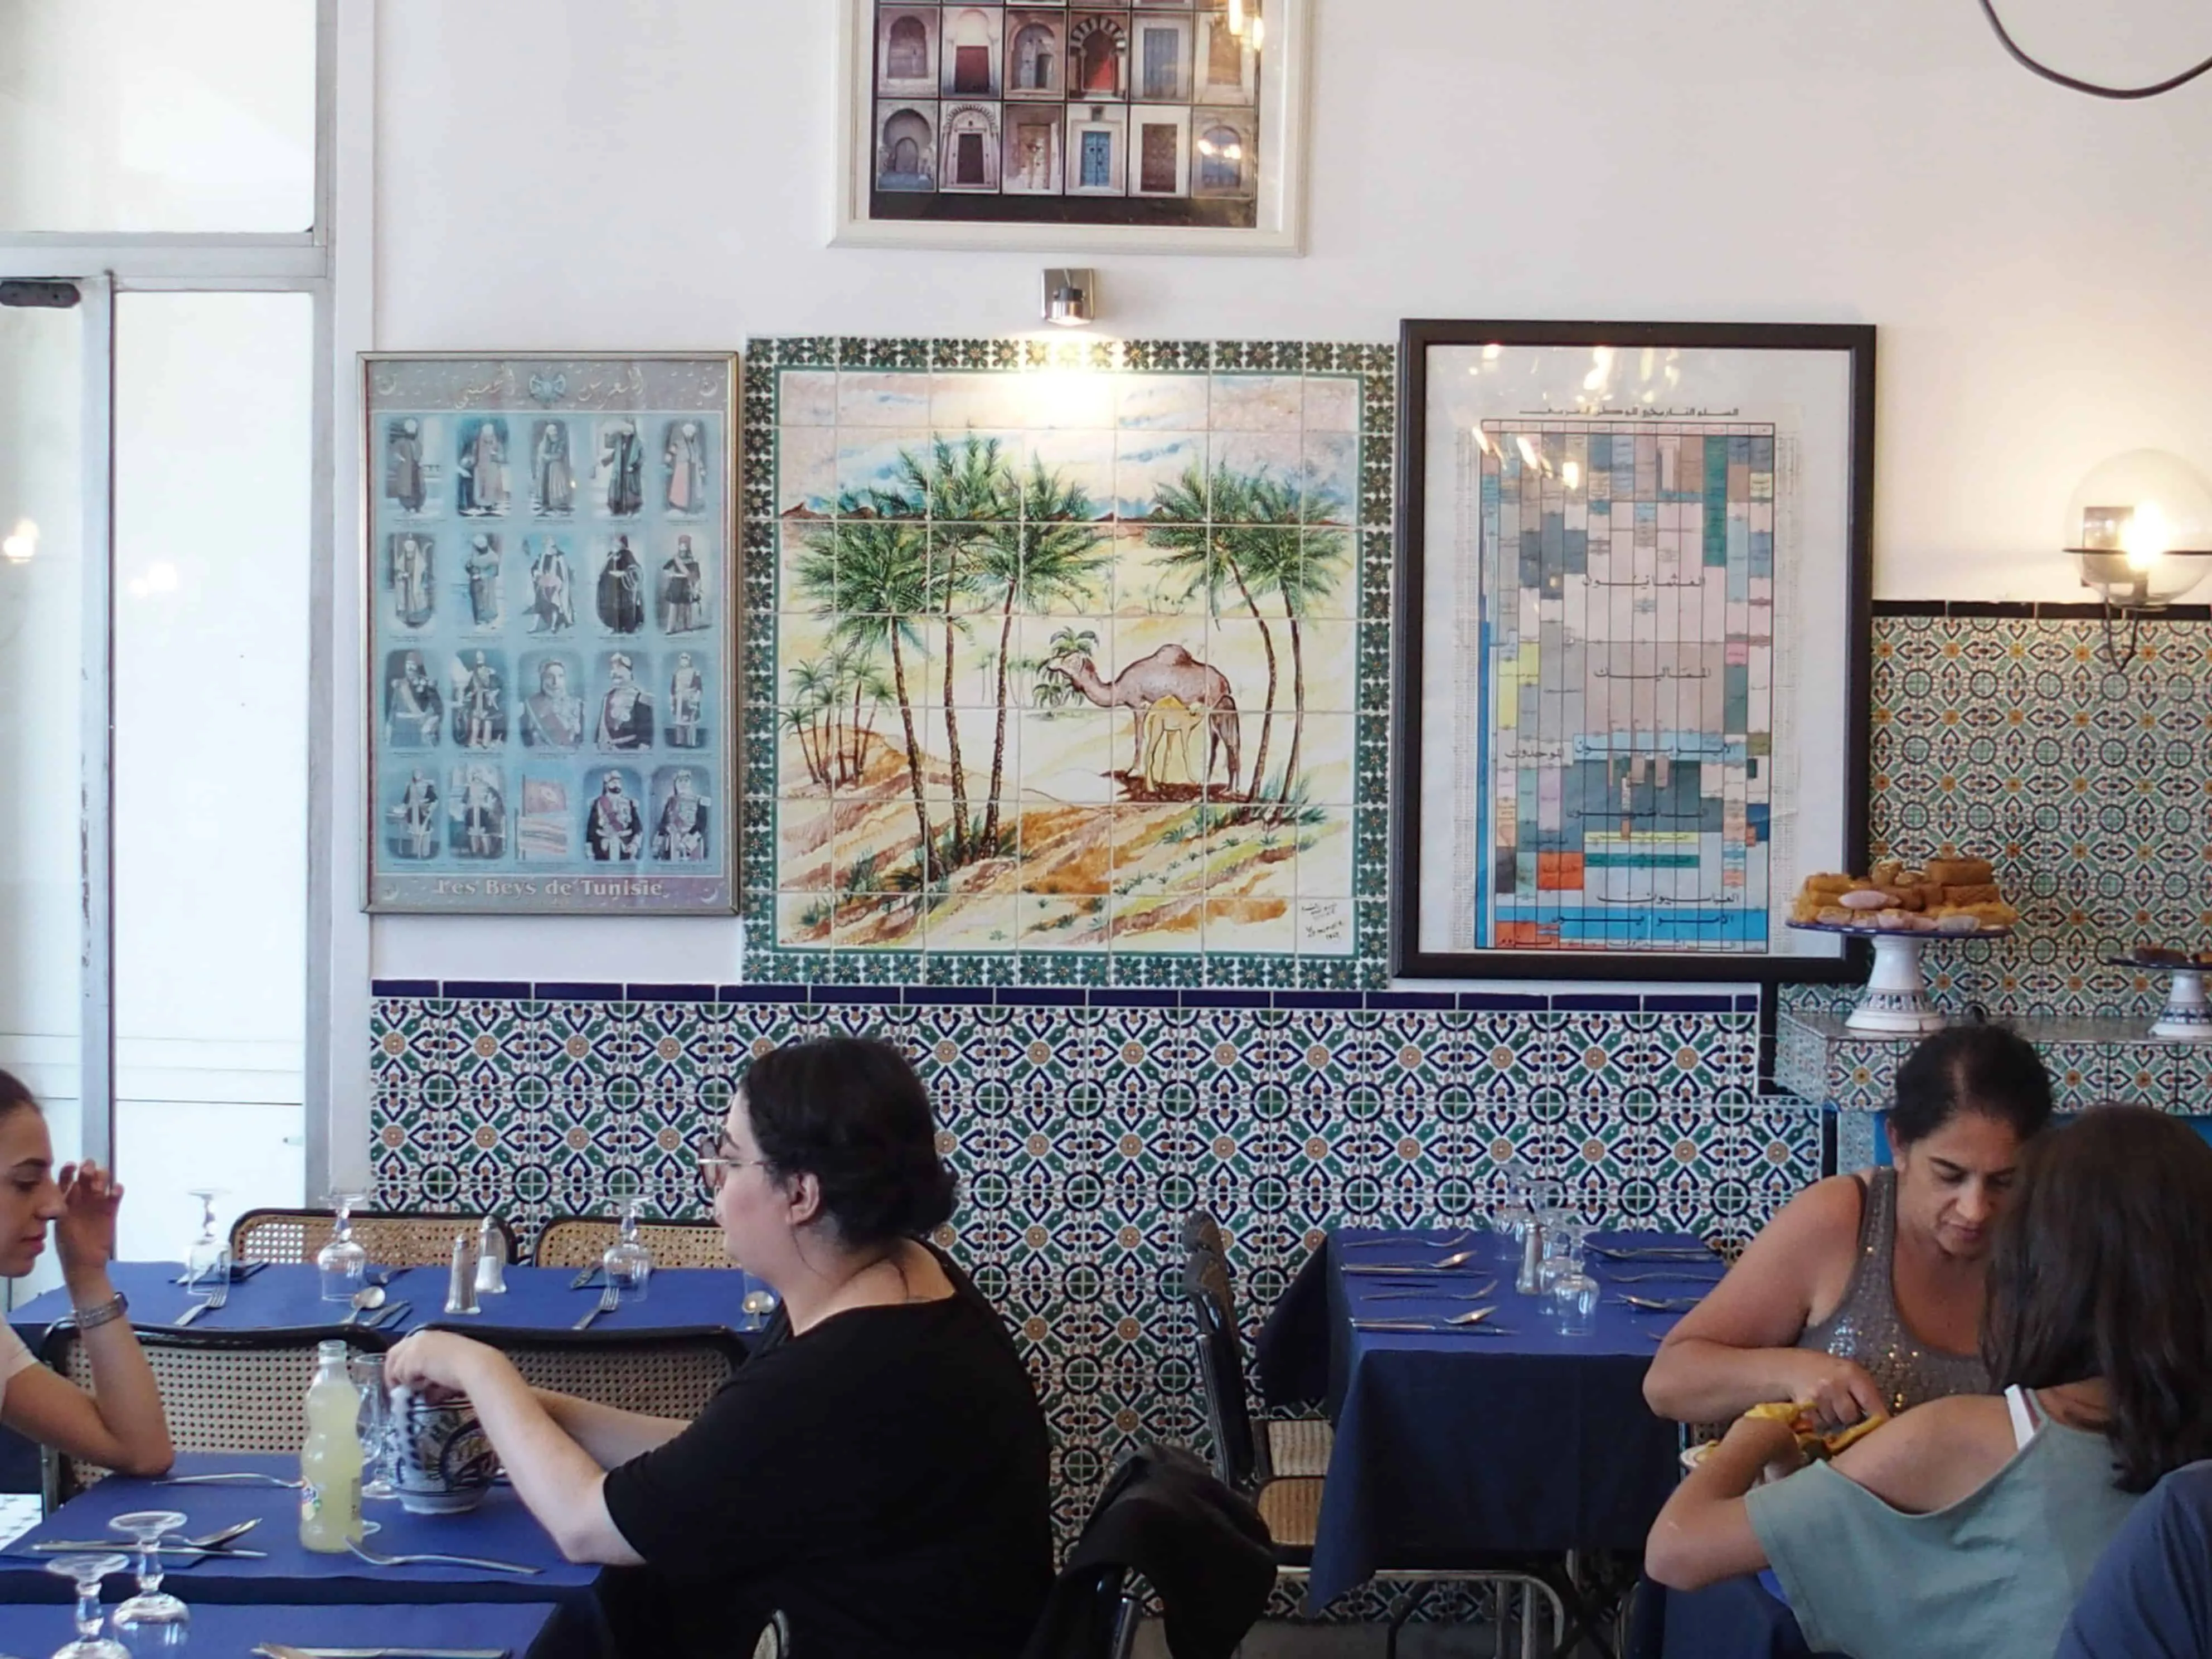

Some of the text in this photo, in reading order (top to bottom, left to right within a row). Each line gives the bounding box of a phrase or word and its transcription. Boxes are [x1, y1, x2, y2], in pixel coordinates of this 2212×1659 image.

[486, 879, 536, 900] Beys
[545, 879, 572, 896] de
[581, 879, 663, 900] Tunisie
